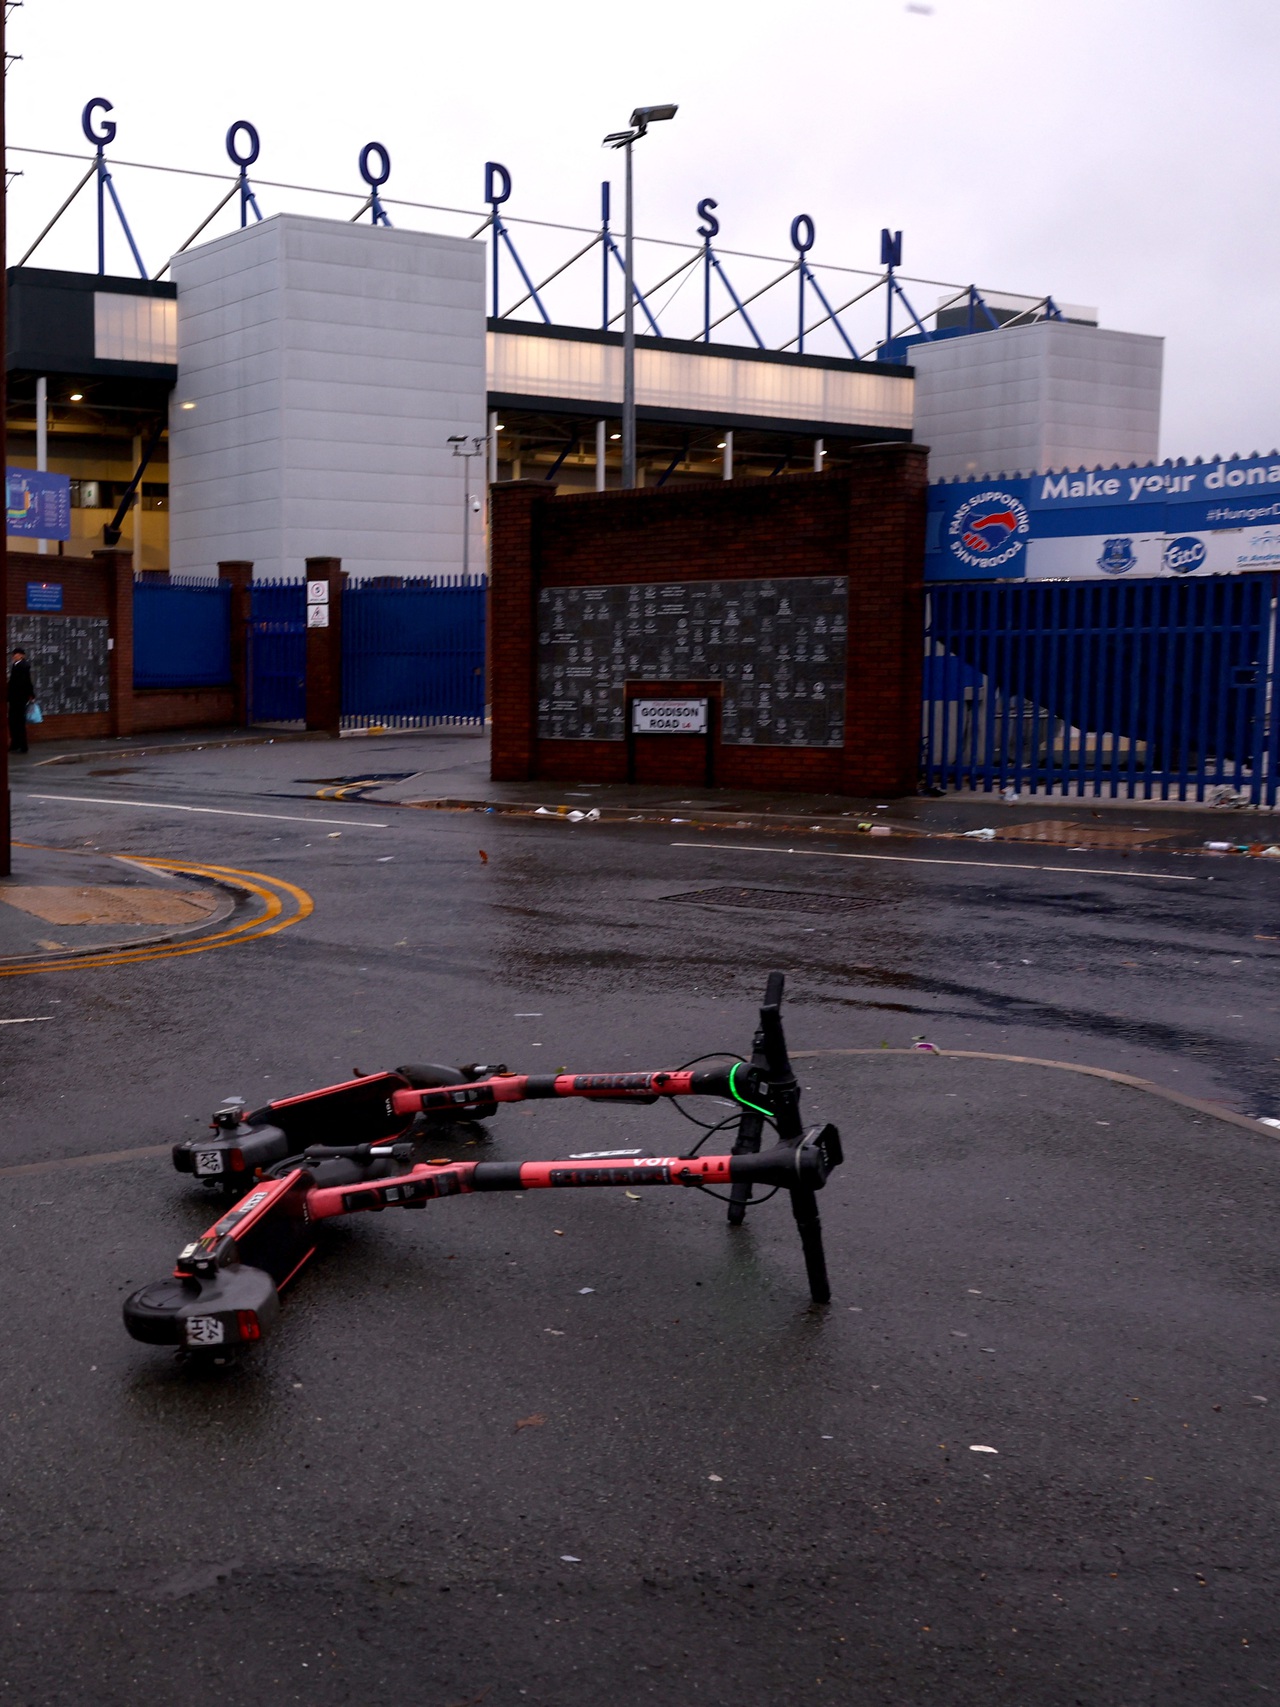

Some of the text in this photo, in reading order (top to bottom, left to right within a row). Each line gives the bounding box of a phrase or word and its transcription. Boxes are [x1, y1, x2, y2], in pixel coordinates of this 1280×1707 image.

[81, 96, 903, 267] GOODISON
[1040, 473, 1121, 500] Make
[1128, 473, 1197, 501] your
[949, 491, 1030, 535] FANS SUPPORTING
[950, 540, 1024, 569] FOODBANKS
[641, 707, 699, 717] GOODISON
[649, 719, 680, 729] ROAD
[191, 1319, 205, 1342] HV
[206, 1319, 220, 1340] Z4
